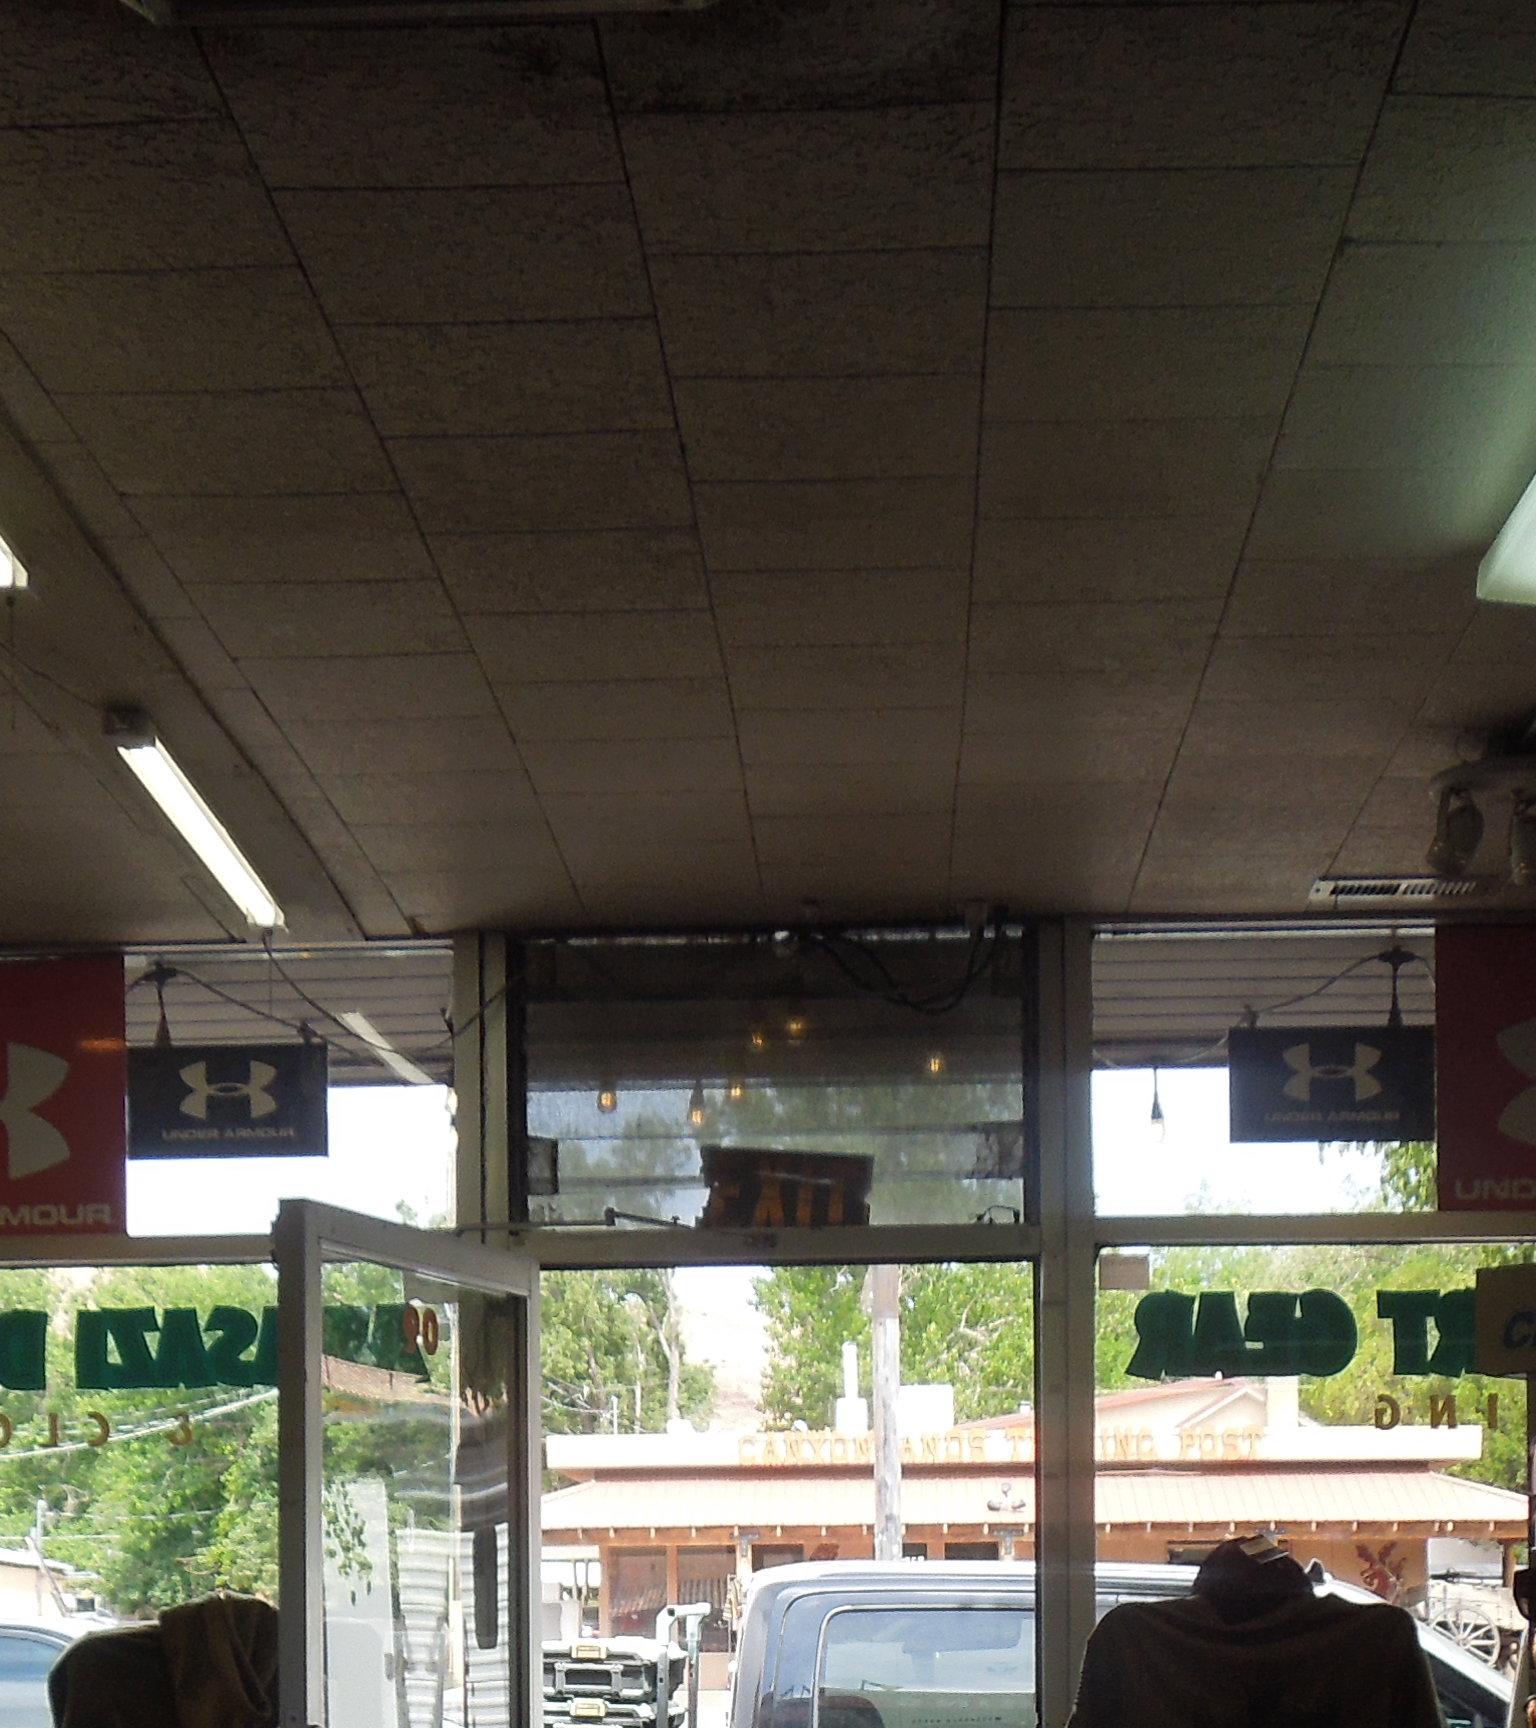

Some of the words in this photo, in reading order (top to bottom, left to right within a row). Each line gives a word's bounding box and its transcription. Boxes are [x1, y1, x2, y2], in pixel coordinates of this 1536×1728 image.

[161, 1128, 221, 1141] UNDER
[223, 1126, 296, 1140] ARMOUR
[738, 1427, 985, 1463] CANYONANDS
